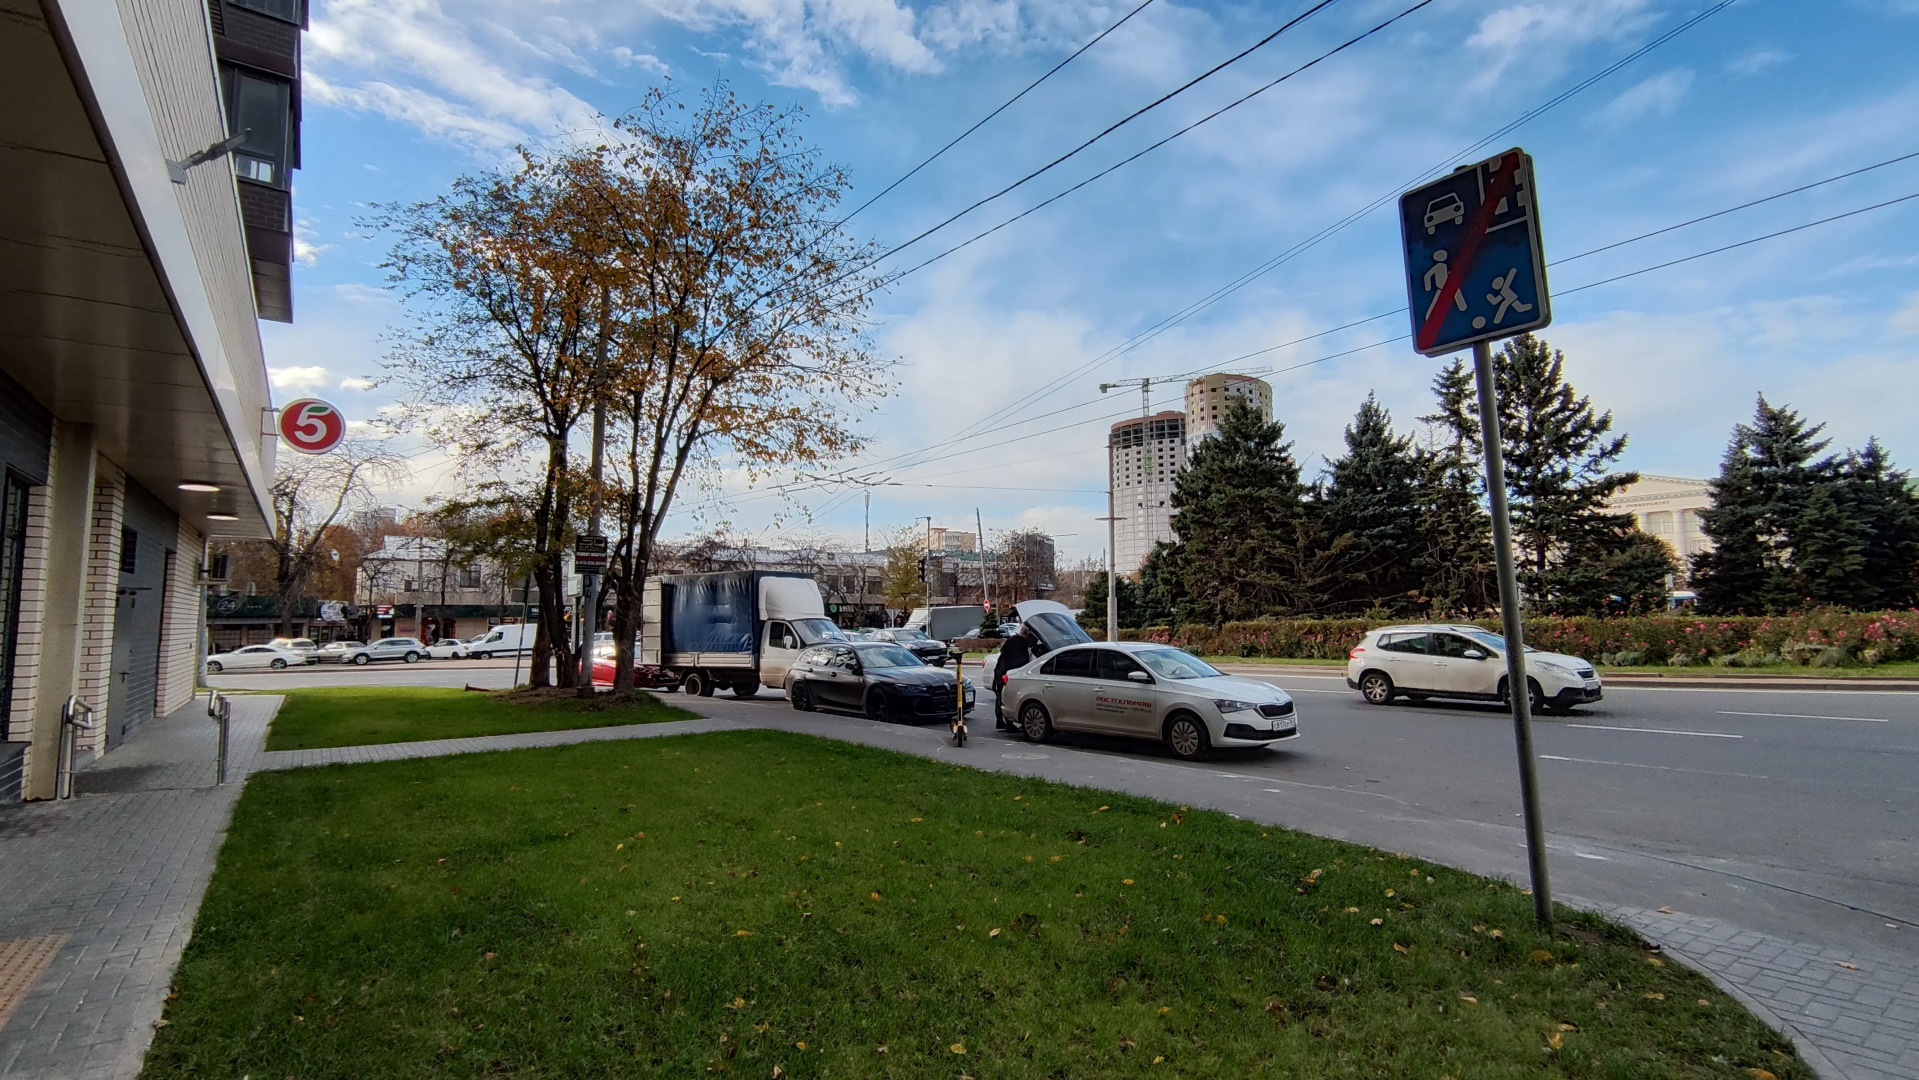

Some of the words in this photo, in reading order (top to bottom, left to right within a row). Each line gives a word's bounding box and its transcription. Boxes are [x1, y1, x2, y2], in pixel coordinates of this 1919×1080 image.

[294, 403, 332, 443] 5
[220, 601, 236, 610] 24
[1096, 696, 1152, 708] РОСТСЕЛЬМАШ
